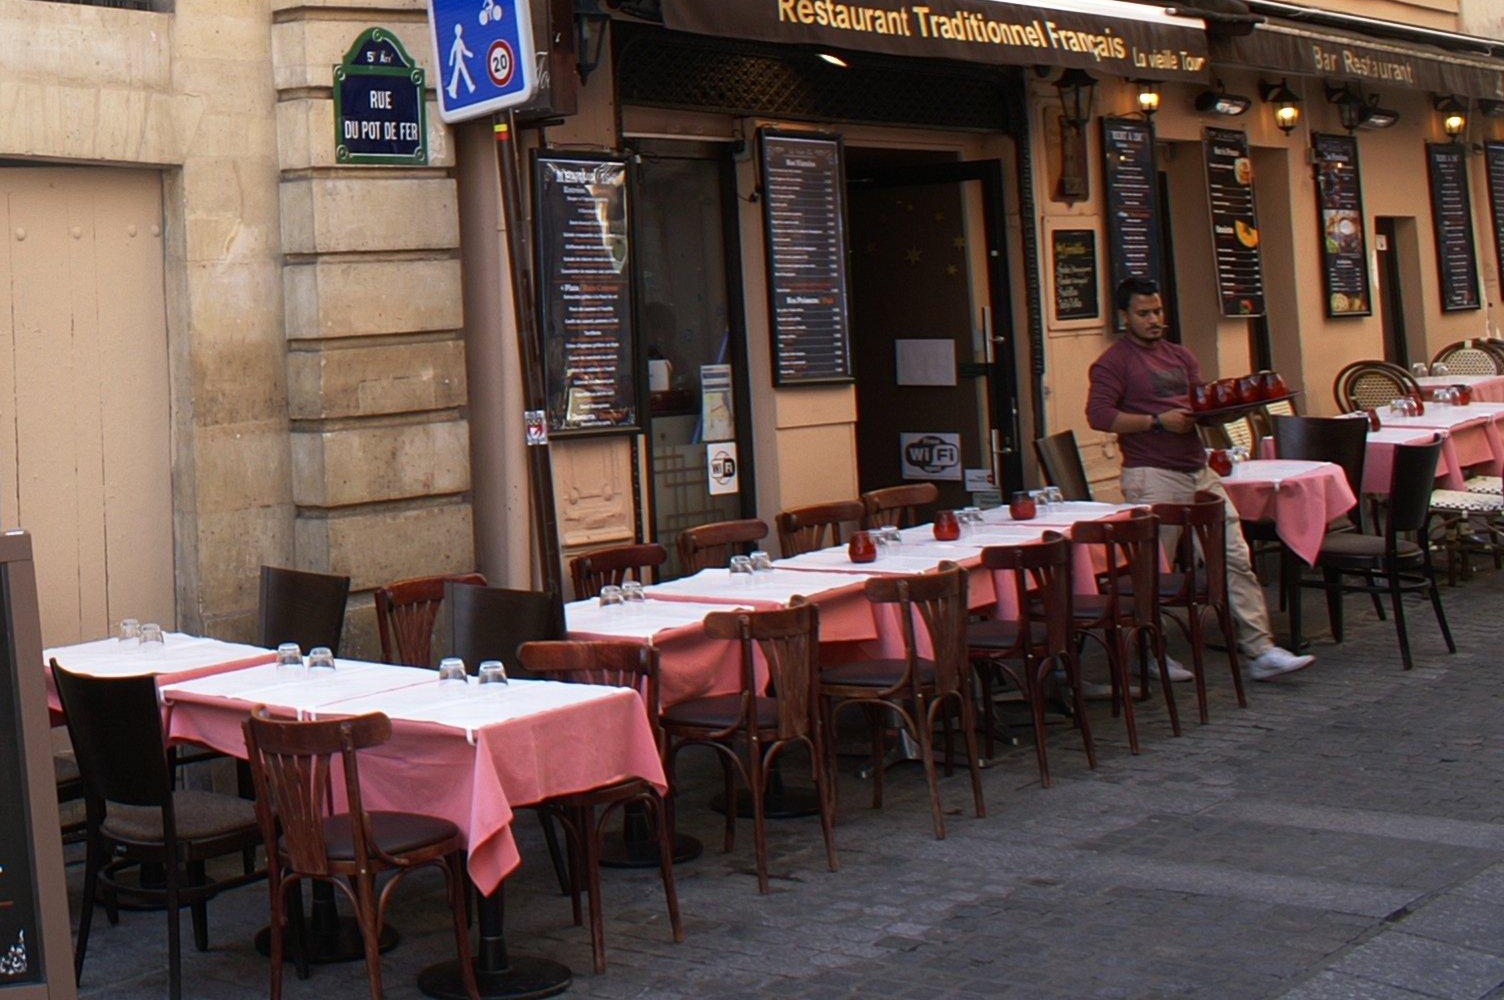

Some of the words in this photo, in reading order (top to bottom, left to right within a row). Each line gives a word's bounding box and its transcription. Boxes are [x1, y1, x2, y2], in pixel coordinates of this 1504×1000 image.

[912, 6, 1048, 49] Traditionnel
[1047, 21, 1126, 62] Français
[1133, 47, 1147, 68] La
[492, 54, 508, 73] 20
[1312, 45, 1337, 71] Bar
[1342, 50, 1414, 84] Restaurant
[369, 90, 392, 109] RUE
[345, 120, 360, 139] DU
[361, 121, 380, 139] POT
[384, 121, 398, 140] DE
[399, 122, 418, 141] FER
